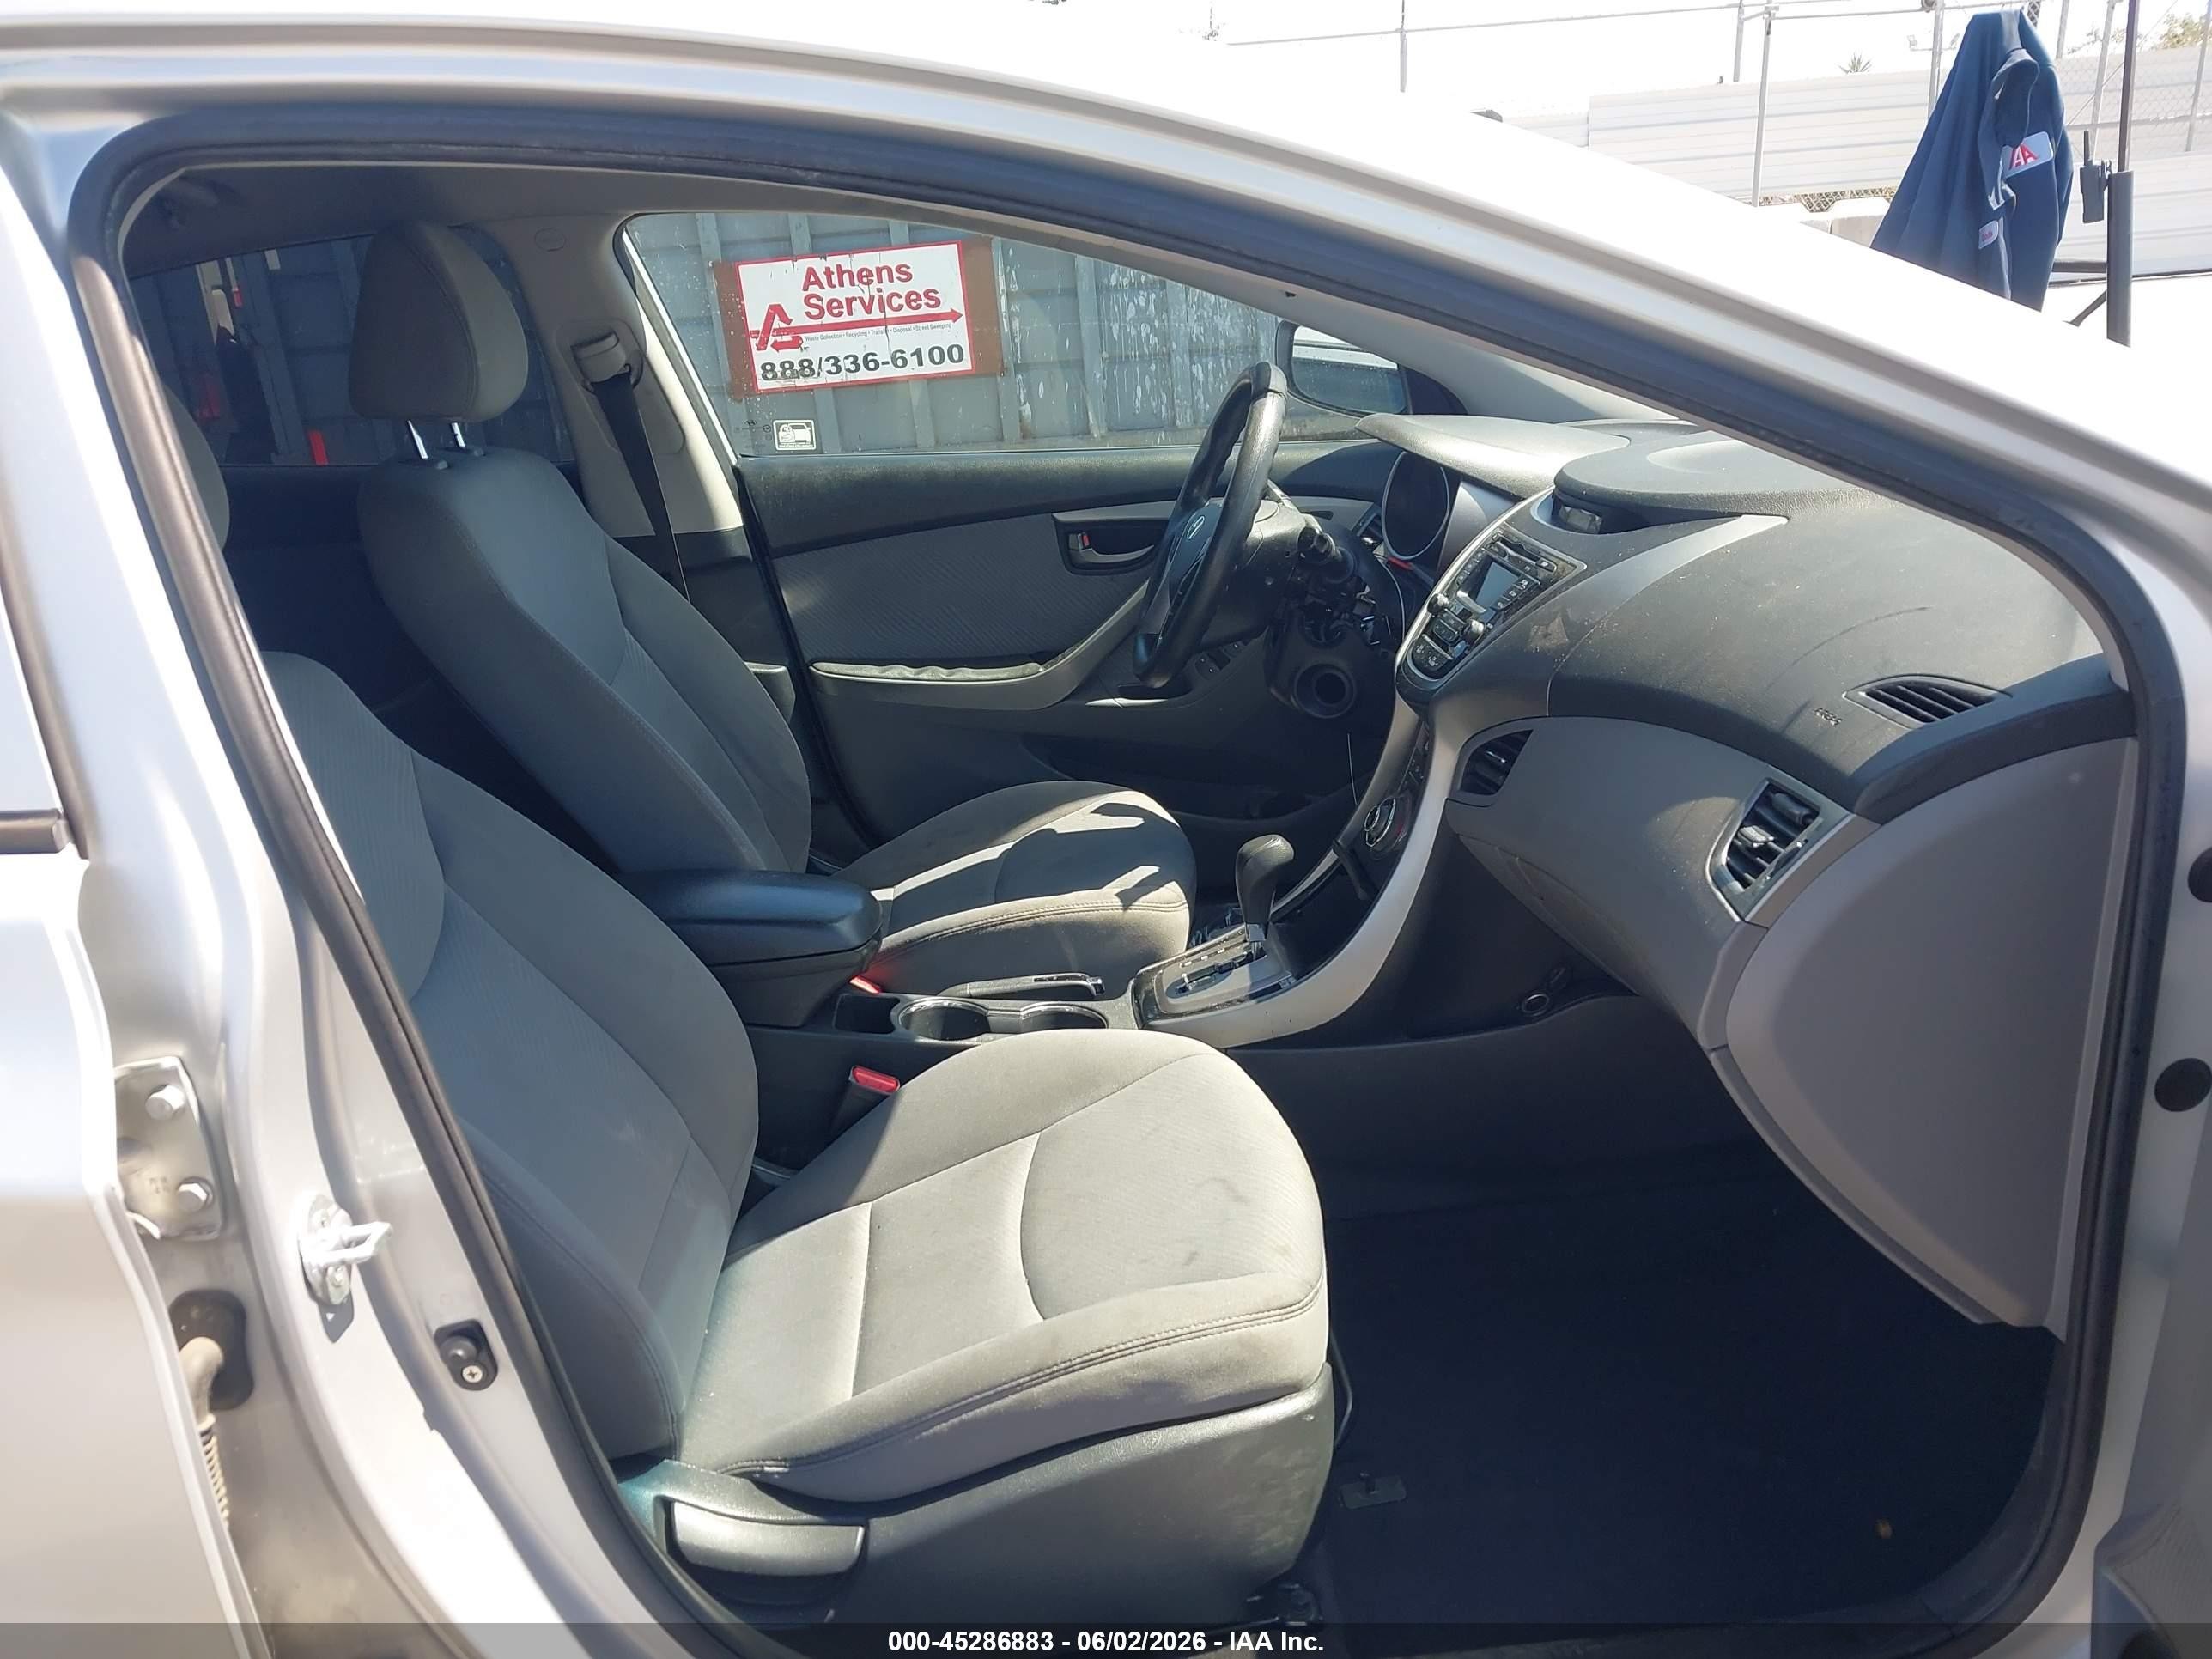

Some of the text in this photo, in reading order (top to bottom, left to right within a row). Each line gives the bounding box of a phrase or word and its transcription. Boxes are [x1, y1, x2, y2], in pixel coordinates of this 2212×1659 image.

[802, 264, 913, 292] Athens
[803, 288, 941, 320] Services
[761, 343, 964, 381] 888/336-6100
